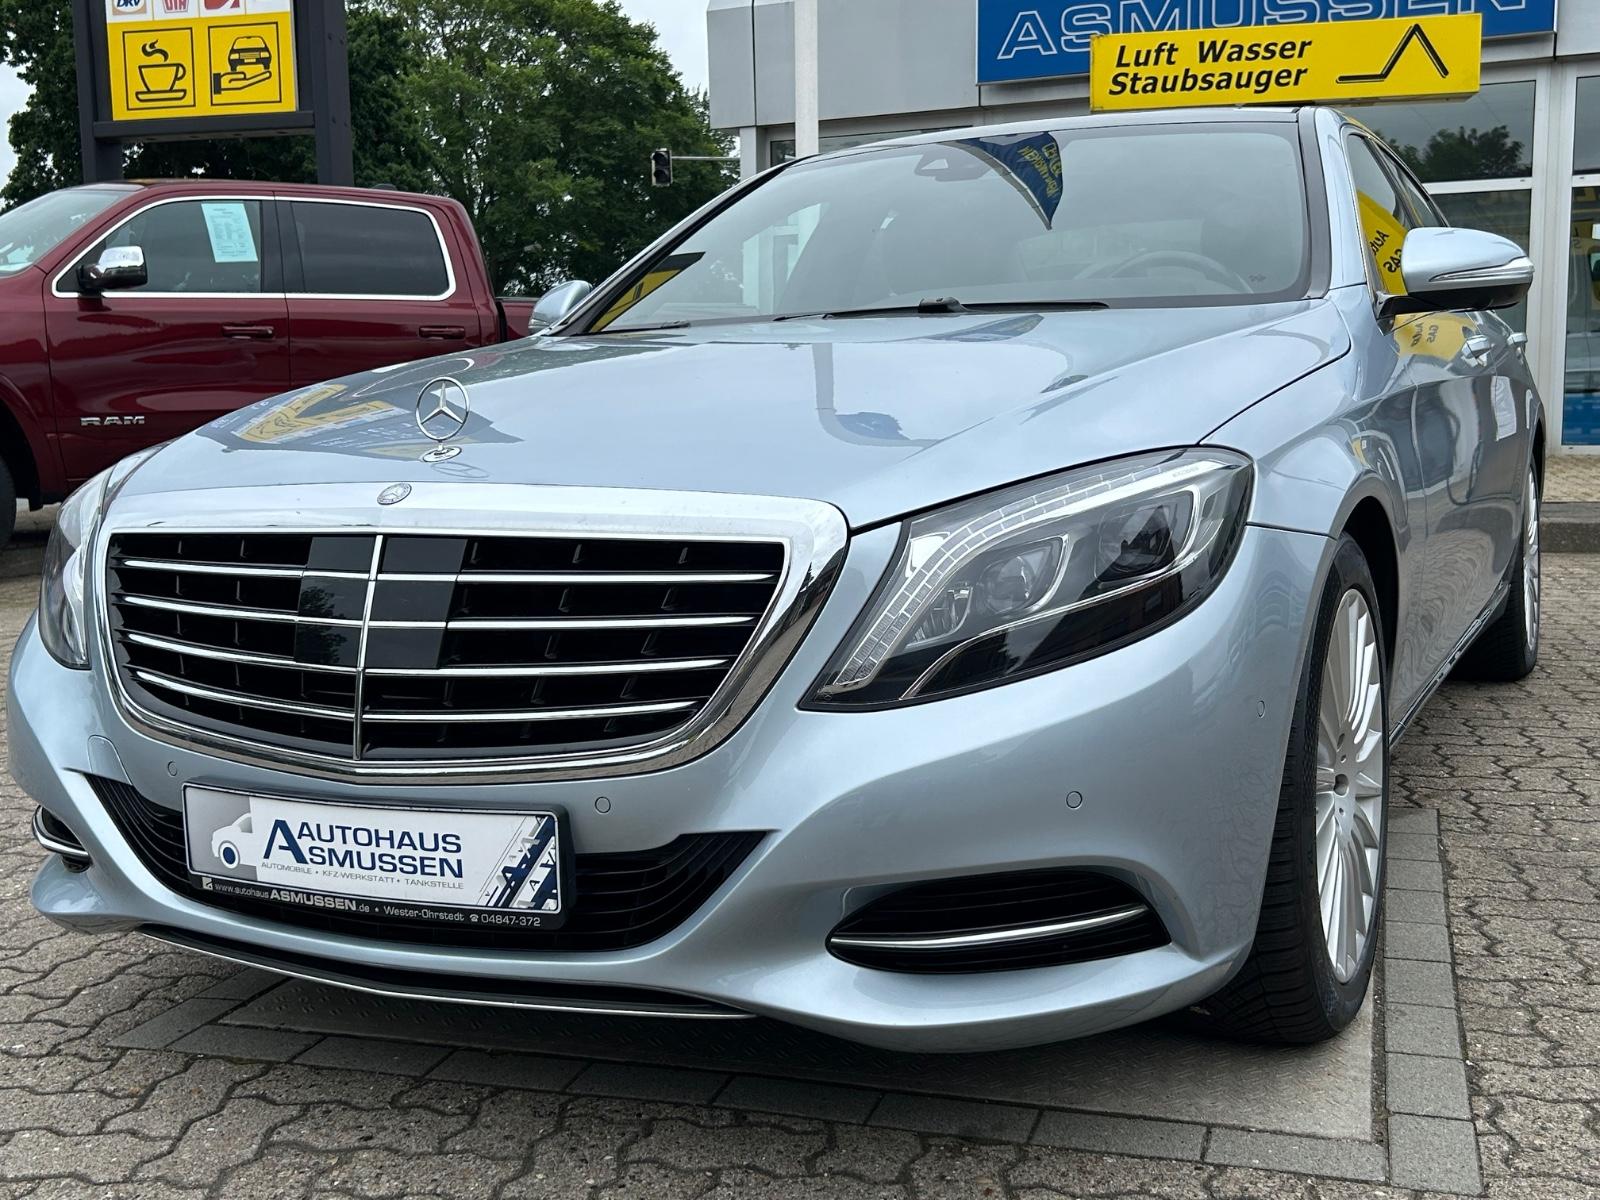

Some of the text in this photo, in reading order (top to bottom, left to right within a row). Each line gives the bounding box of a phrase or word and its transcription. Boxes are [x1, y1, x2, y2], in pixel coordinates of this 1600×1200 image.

[1115, 40, 1313, 68] Luft Wasser
[1108, 67, 1308, 96] Staubsauger
[80, 415, 145, 426] RAM
[297, 821, 462, 854] AUTOHAUS
[261, 862, 464, 890] AUTOMOBILE KFZ-WERKSTATT TANKSTELLE
[383, 905, 465, 921] Wester-Ohrstedt
[480, 914, 541, 928] 04847-372
